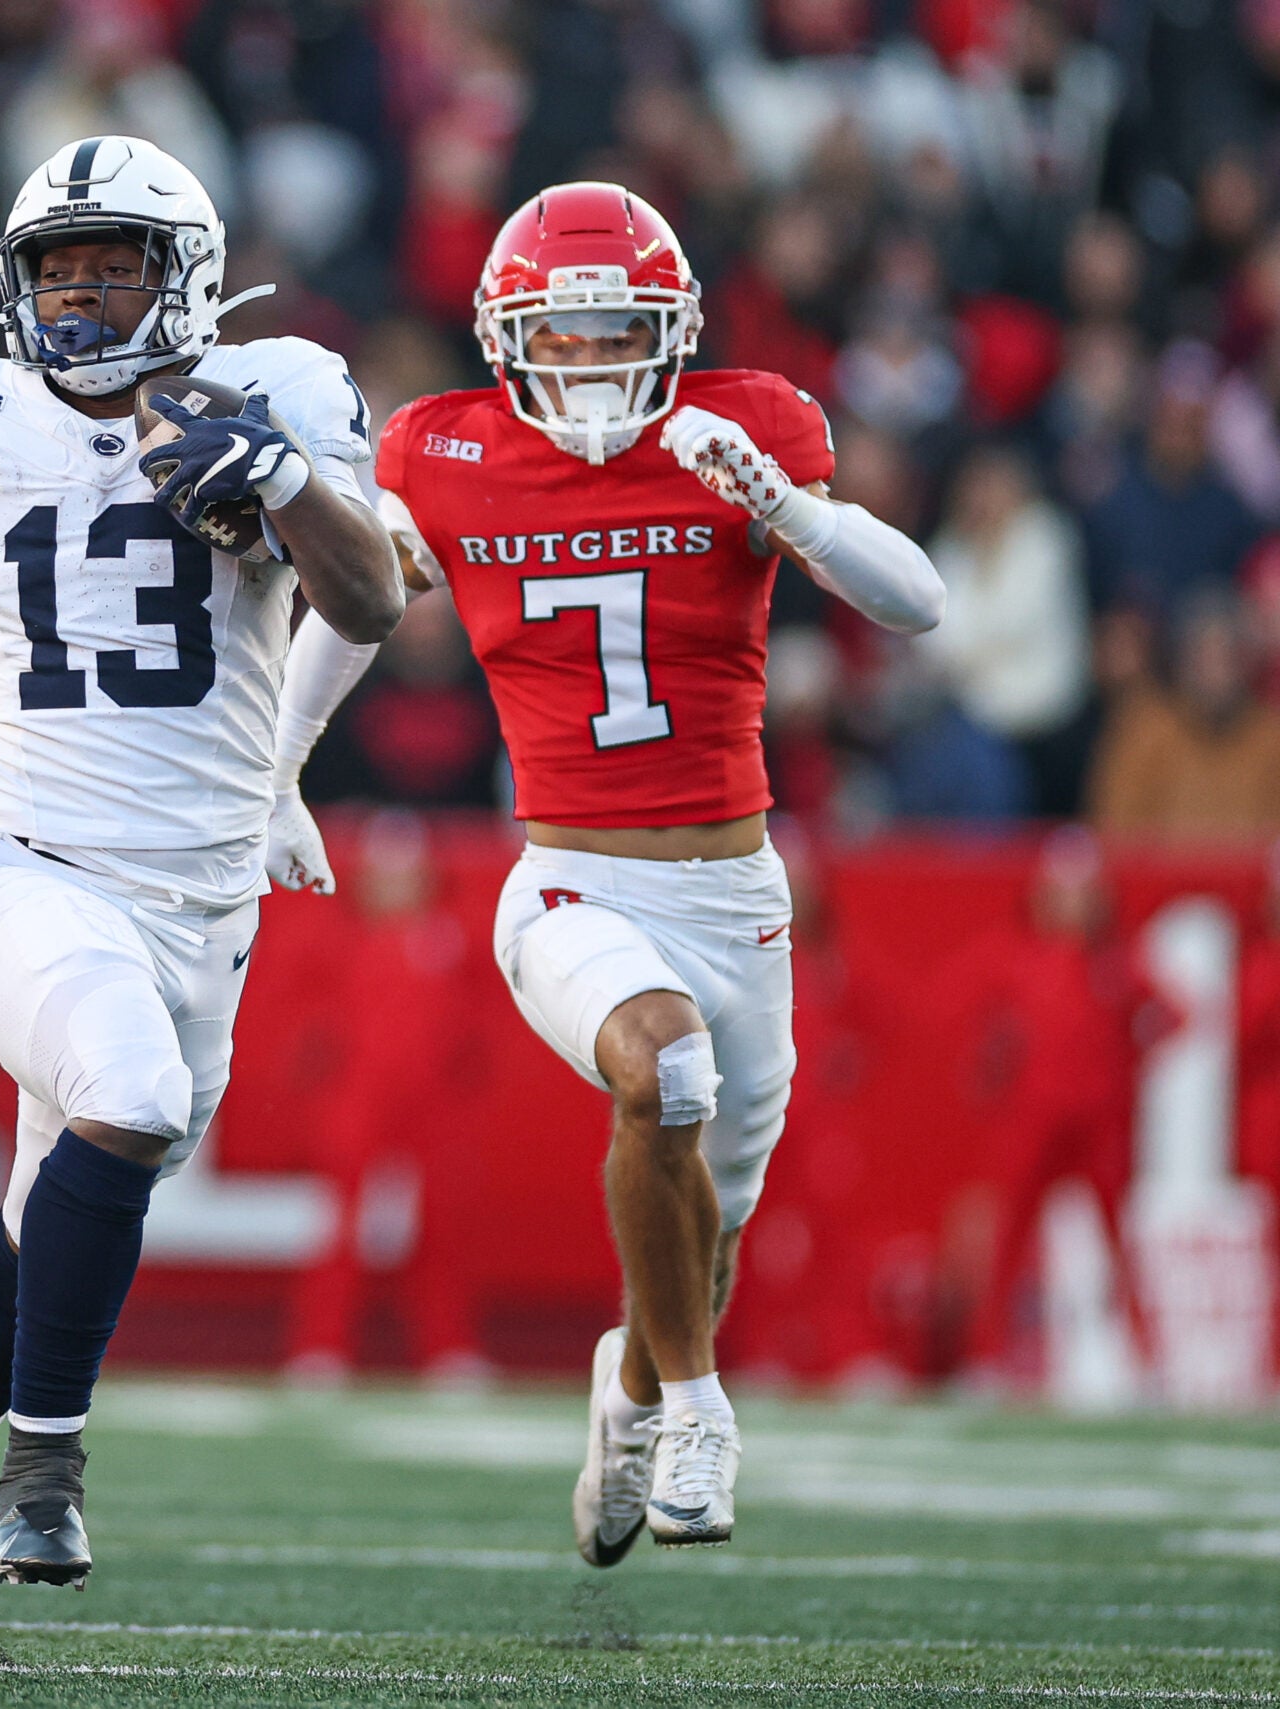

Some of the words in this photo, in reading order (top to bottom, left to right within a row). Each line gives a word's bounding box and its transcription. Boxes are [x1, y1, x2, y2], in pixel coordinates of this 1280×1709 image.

[73, 202, 102, 210] STATE
[458, 525, 714, 565] RUTGERS
[4, 502, 217, 711] 13
[521, 568, 674, 751] 7
